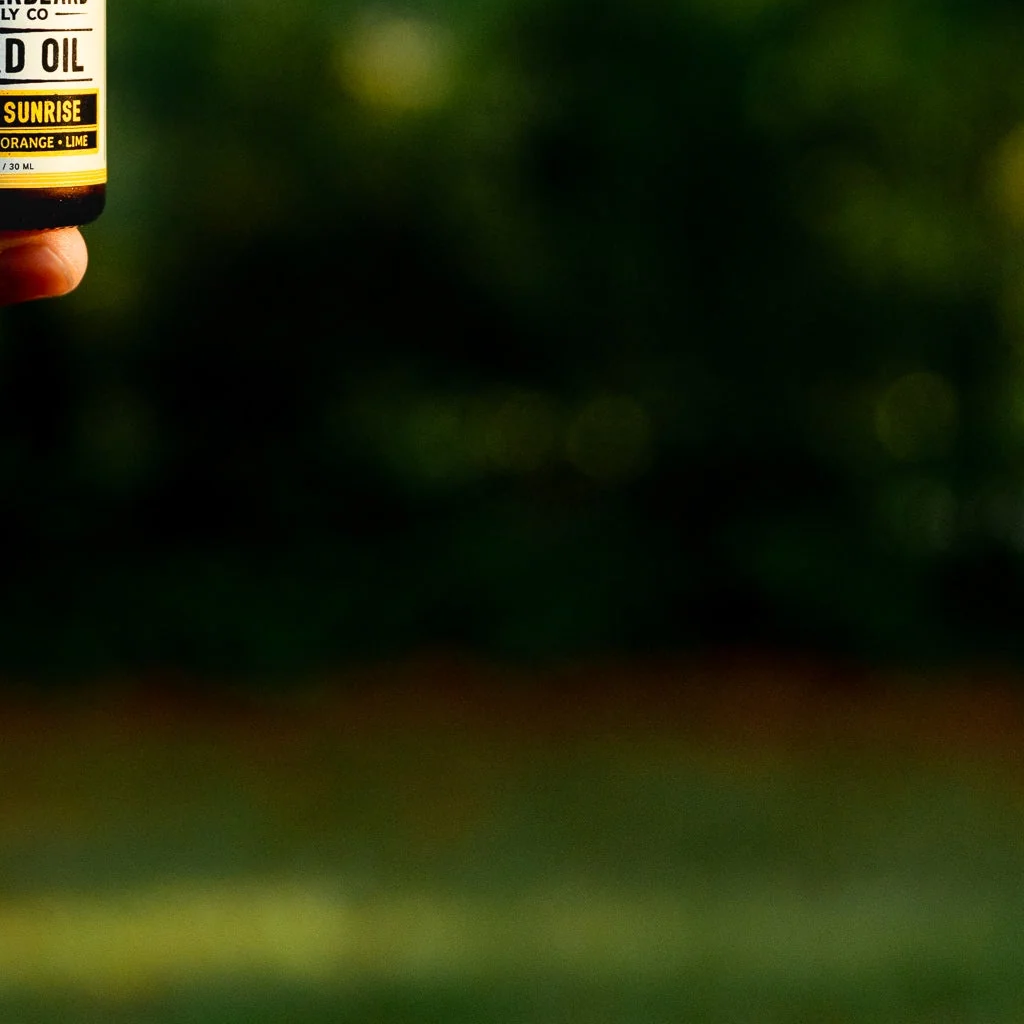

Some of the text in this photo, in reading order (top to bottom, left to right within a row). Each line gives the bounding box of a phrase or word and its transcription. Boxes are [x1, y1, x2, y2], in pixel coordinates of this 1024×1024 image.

[27, 8, 48, 20] CO
[41, 37, 84, 73] OIL
[4, 100, 81, 123] SUNRISE
[0, 136, 54, 149] ORANGE
[66, 135, 88, 148] LIME
[9, 163, 20, 171] 30
[23, 163, 34, 171] ML
